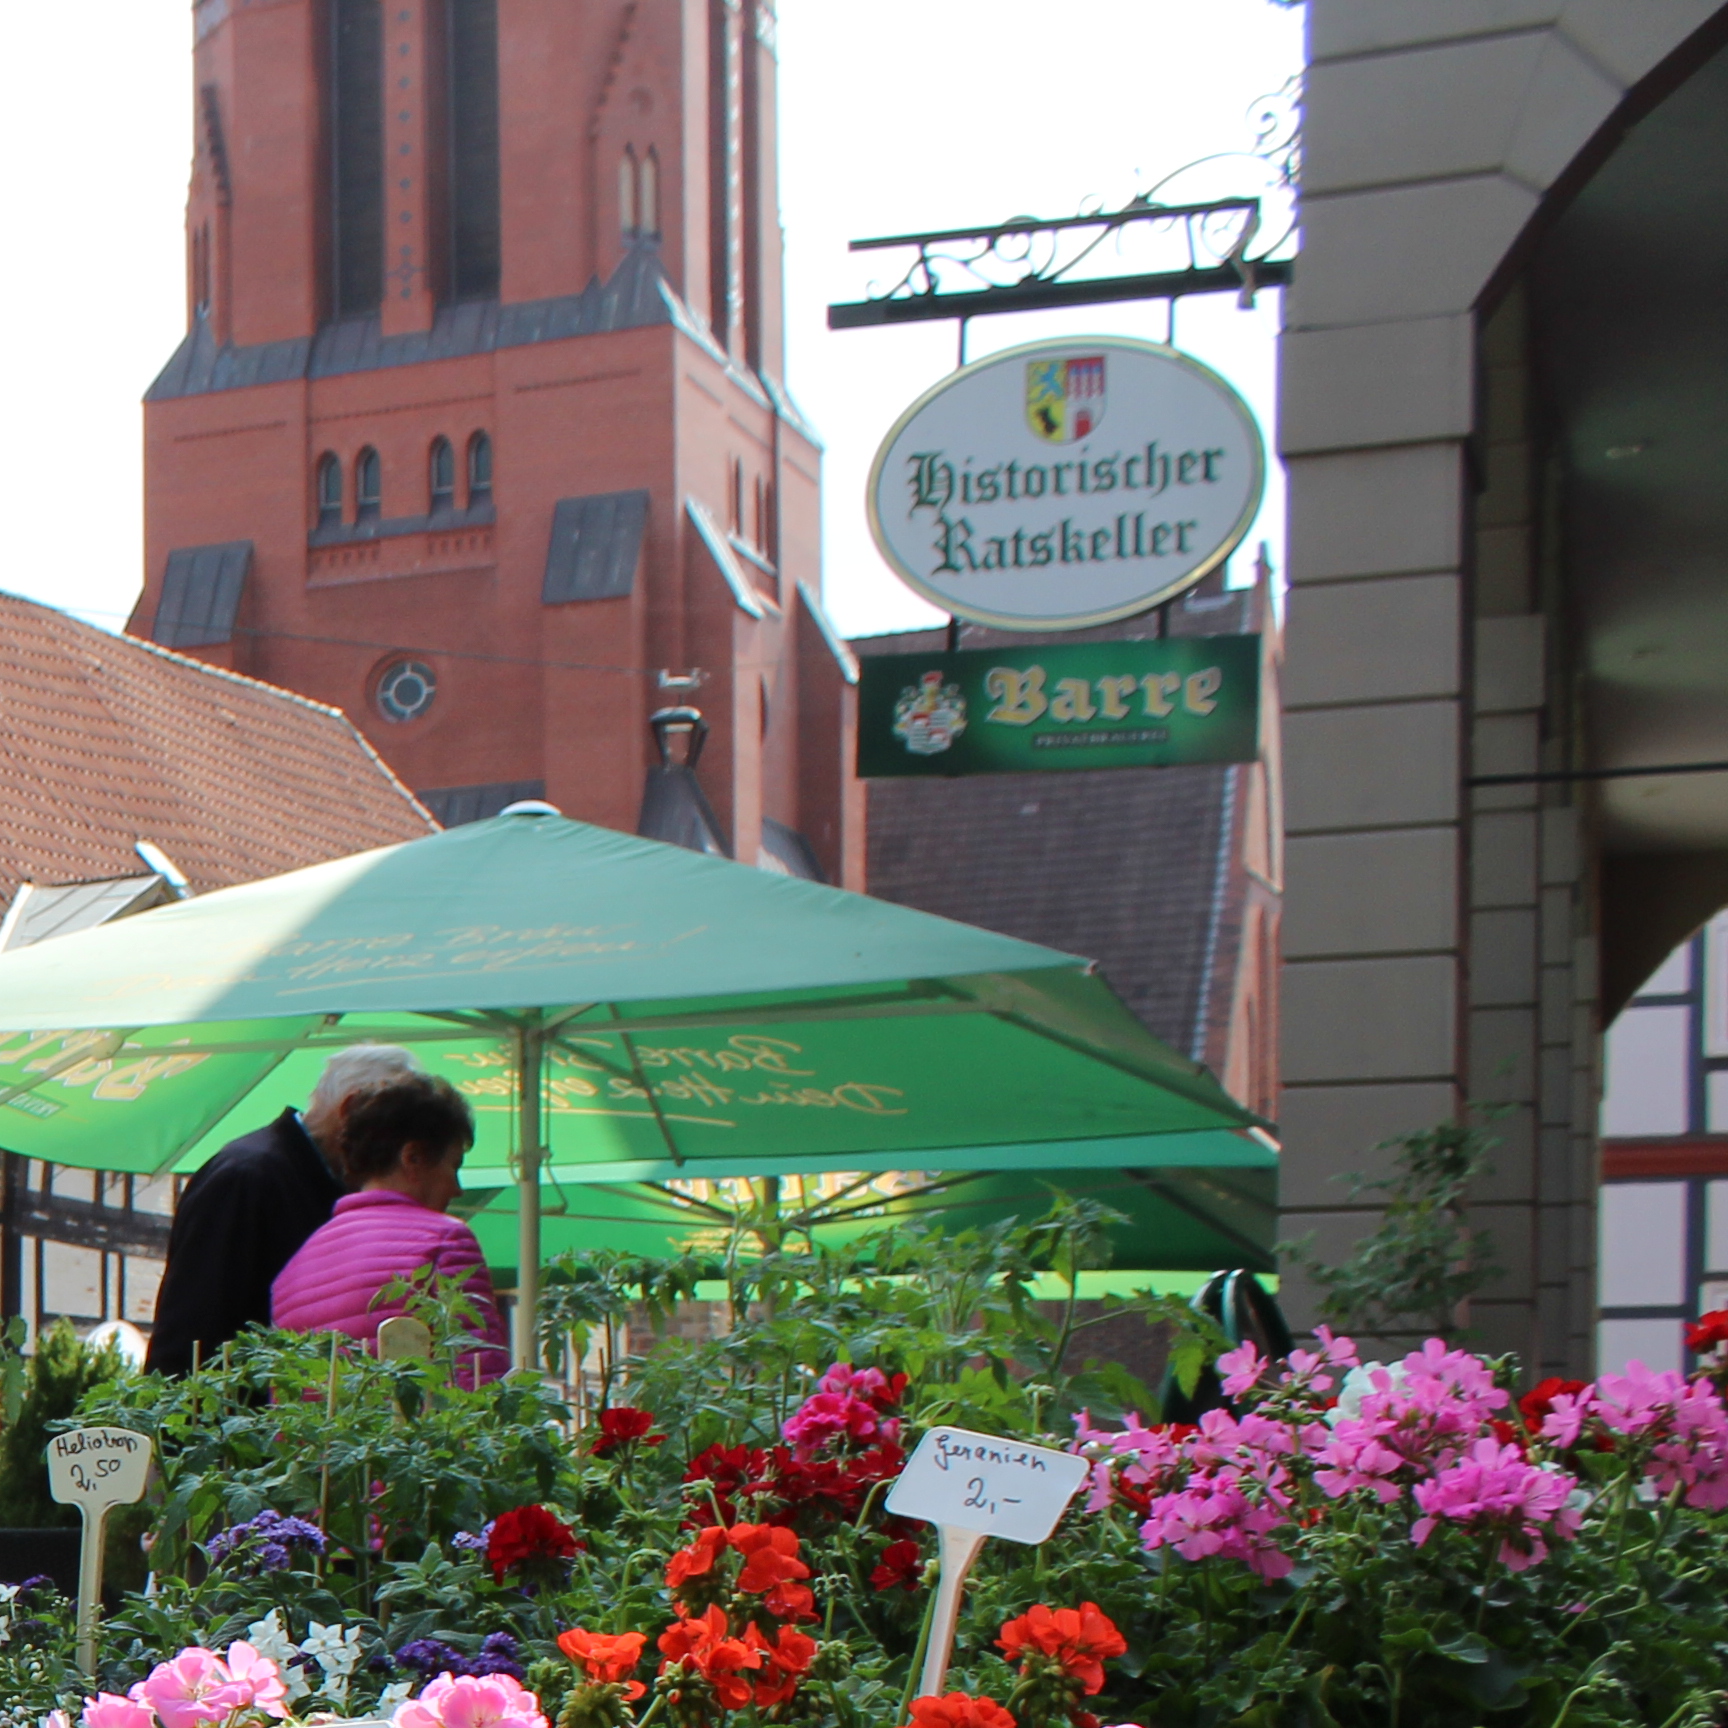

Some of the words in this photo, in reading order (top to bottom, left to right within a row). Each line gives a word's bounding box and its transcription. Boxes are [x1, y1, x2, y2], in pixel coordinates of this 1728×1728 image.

[906, 440, 1226, 519] Historischer
[931, 509, 1198, 576] Ratskeller
[985, 664, 1222, 726] Barre
[56, 1429, 138, 1458] Heliotrop
[934, 1434, 1046, 1472] Geranien
